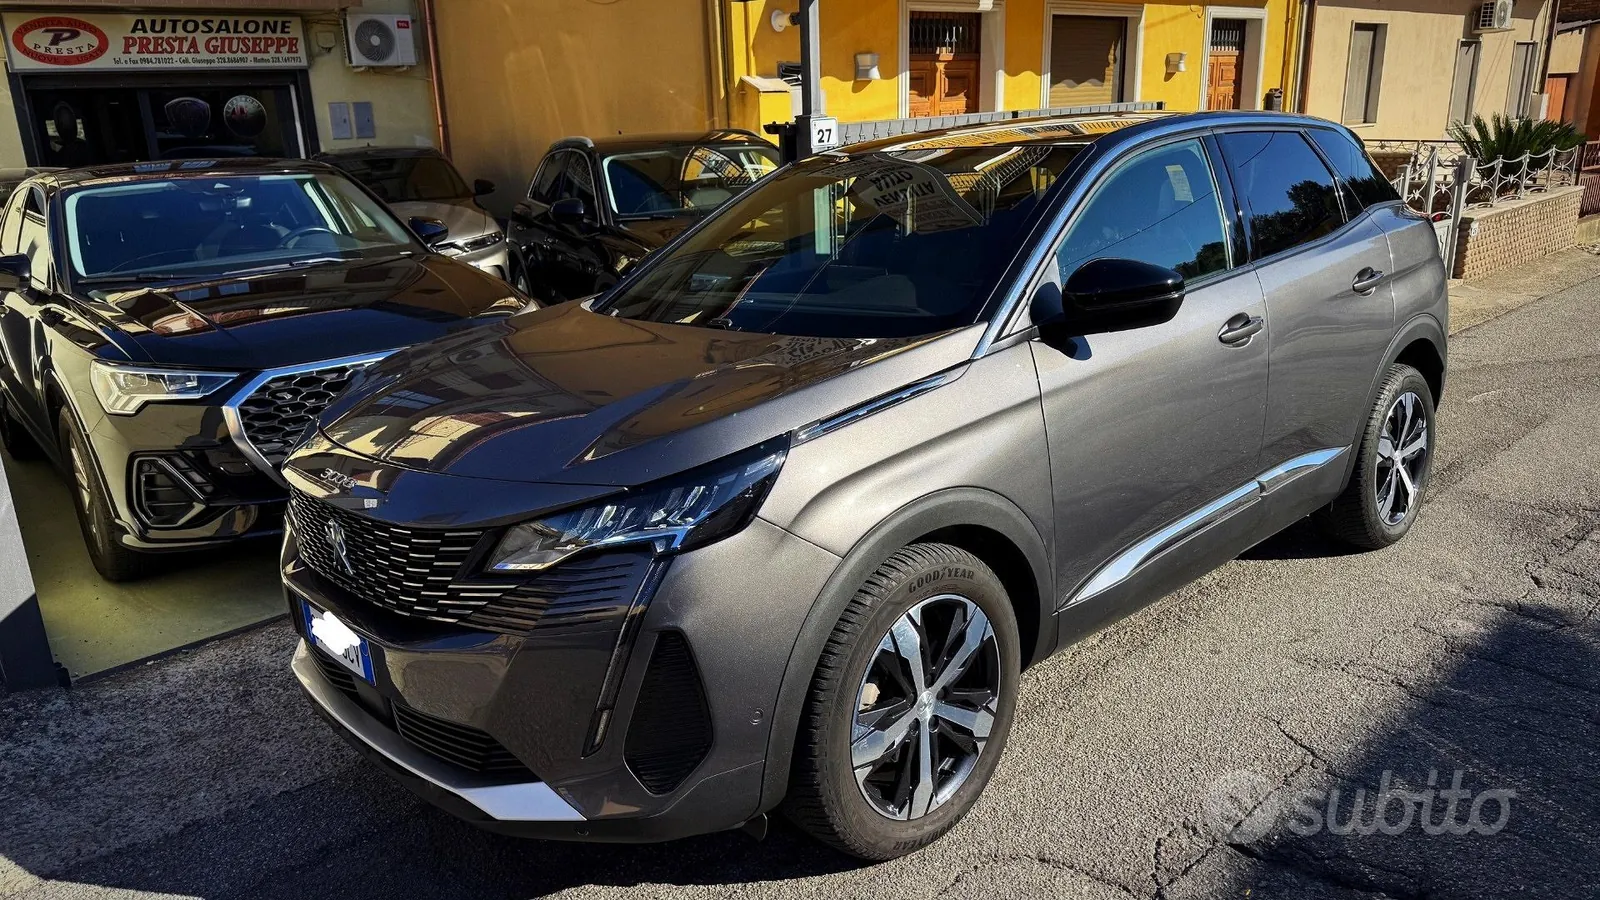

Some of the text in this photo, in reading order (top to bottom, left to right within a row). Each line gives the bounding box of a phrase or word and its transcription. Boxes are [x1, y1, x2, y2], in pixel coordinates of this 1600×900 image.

[130, 18, 292, 35] AUTOSALONE
[41, 28, 81, 46] P
[122, 36, 299, 55] PRESTA GIUSEPPE
[33, 42, 96, 55] PRESTA
[191, 56, 216, 66] Giuseppe
[817, 128, 832, 144] 27
[320, 467, 357, 489] 3008
